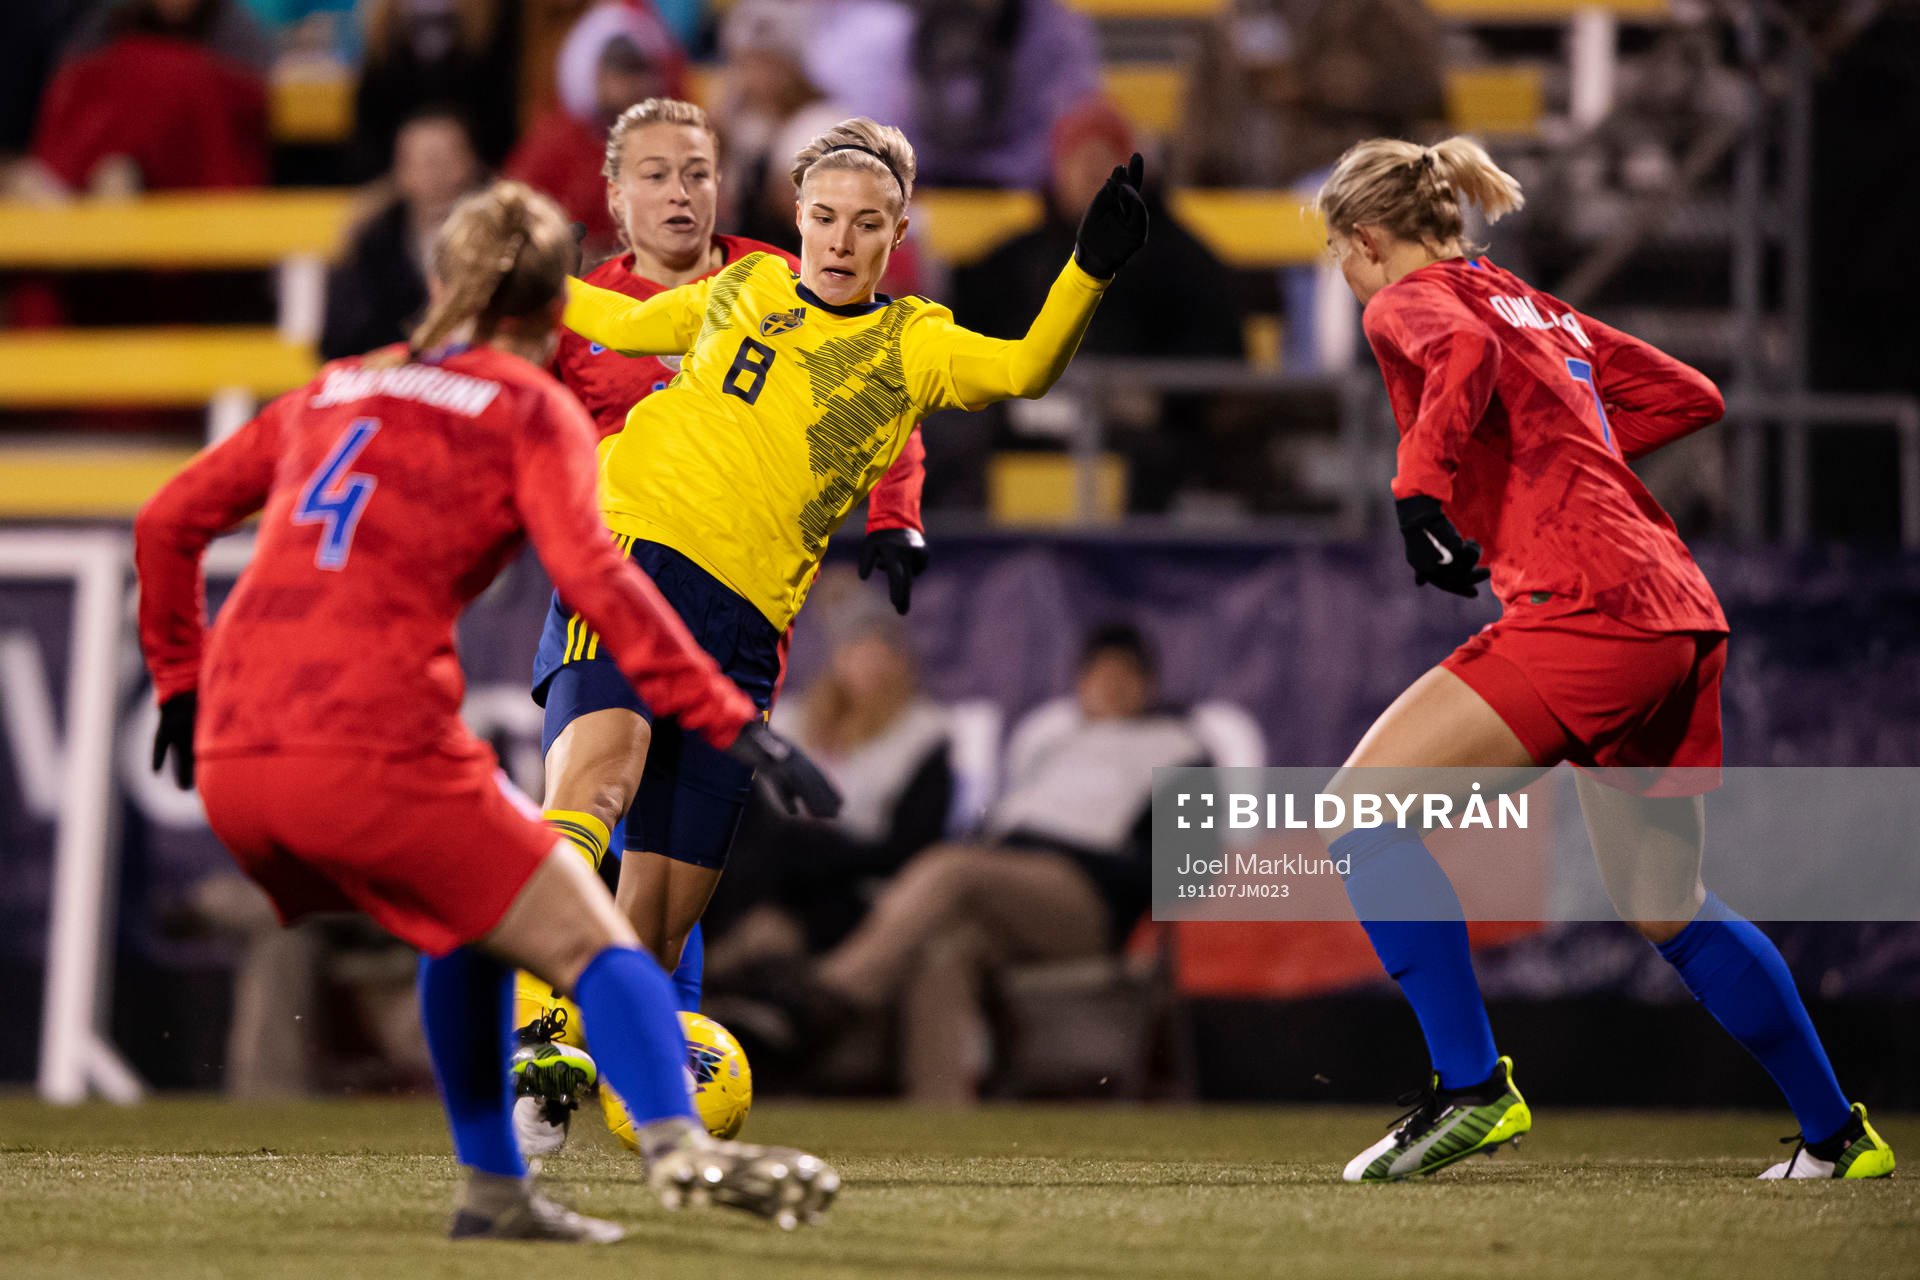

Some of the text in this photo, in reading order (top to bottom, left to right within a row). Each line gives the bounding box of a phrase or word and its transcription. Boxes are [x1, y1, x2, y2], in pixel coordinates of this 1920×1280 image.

[722, 335, 777, 406] 8
[1565, 356, 1619, 458] 7
[290, 417, 382, 571] 4
